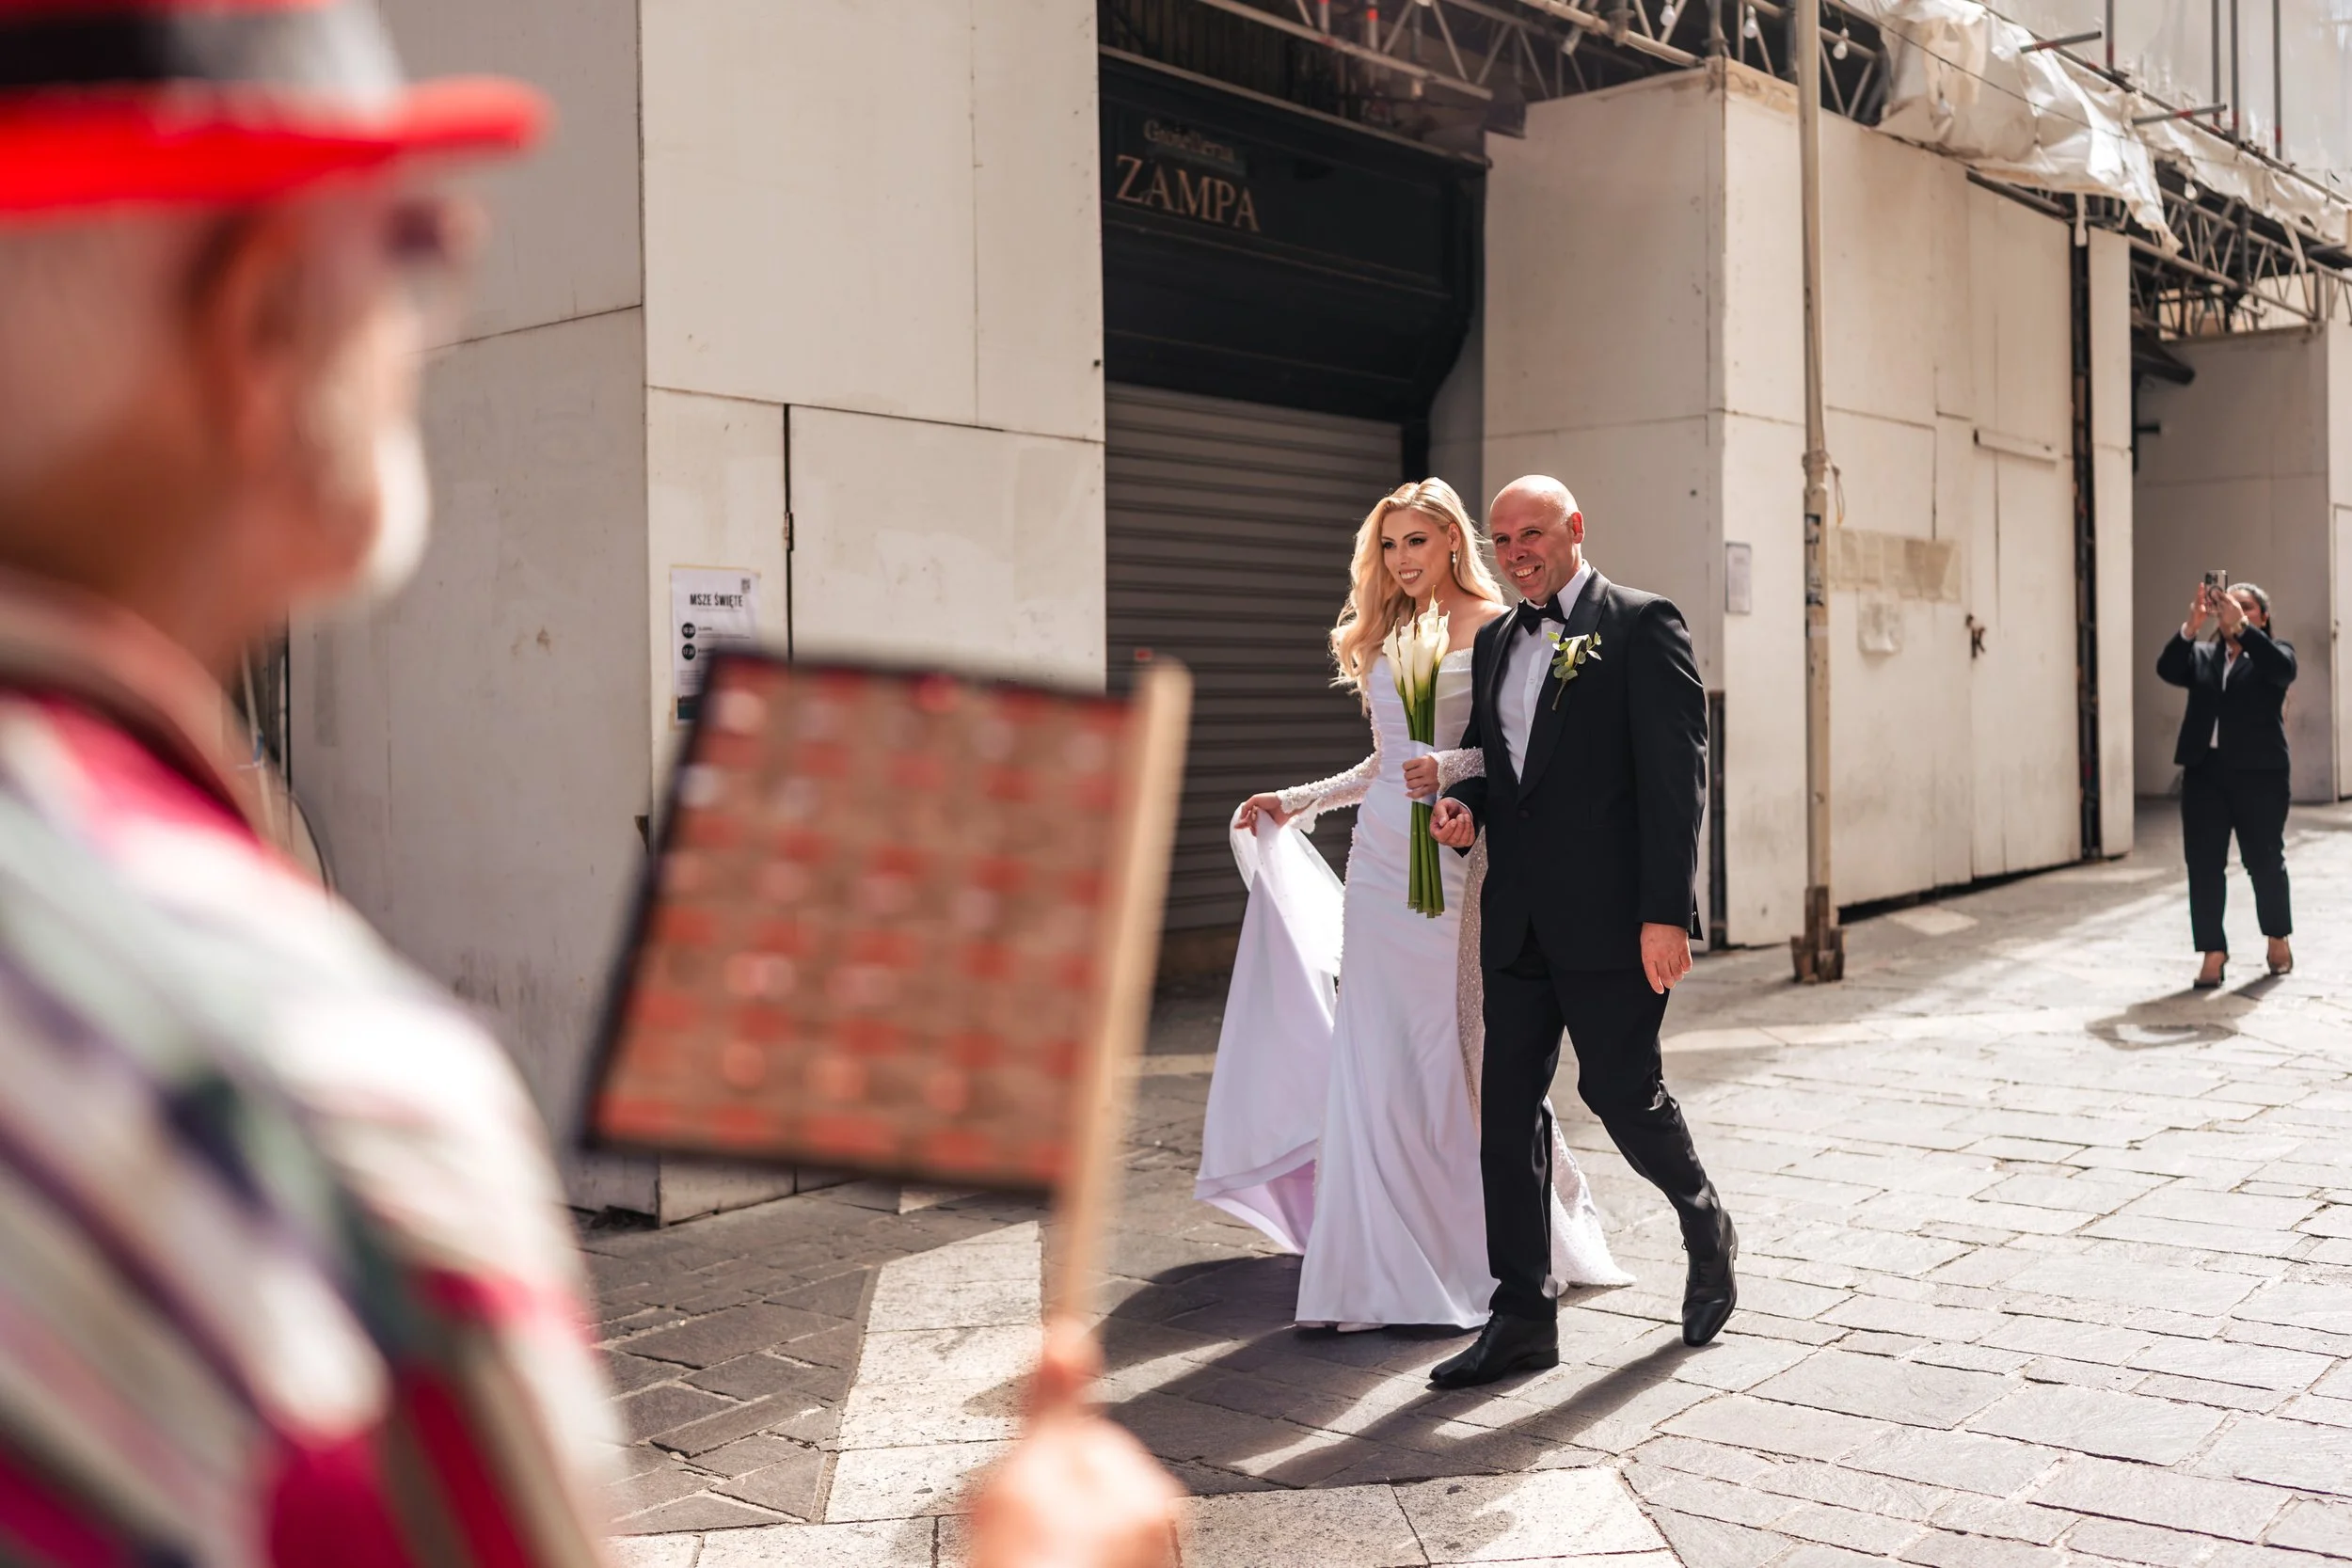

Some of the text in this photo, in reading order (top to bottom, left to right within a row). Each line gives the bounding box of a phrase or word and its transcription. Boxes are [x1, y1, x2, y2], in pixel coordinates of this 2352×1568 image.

[1116, 155, 1261, 232] ZAMPA
[690, 591, 742, 609] MSZE ŚWIĘTE
